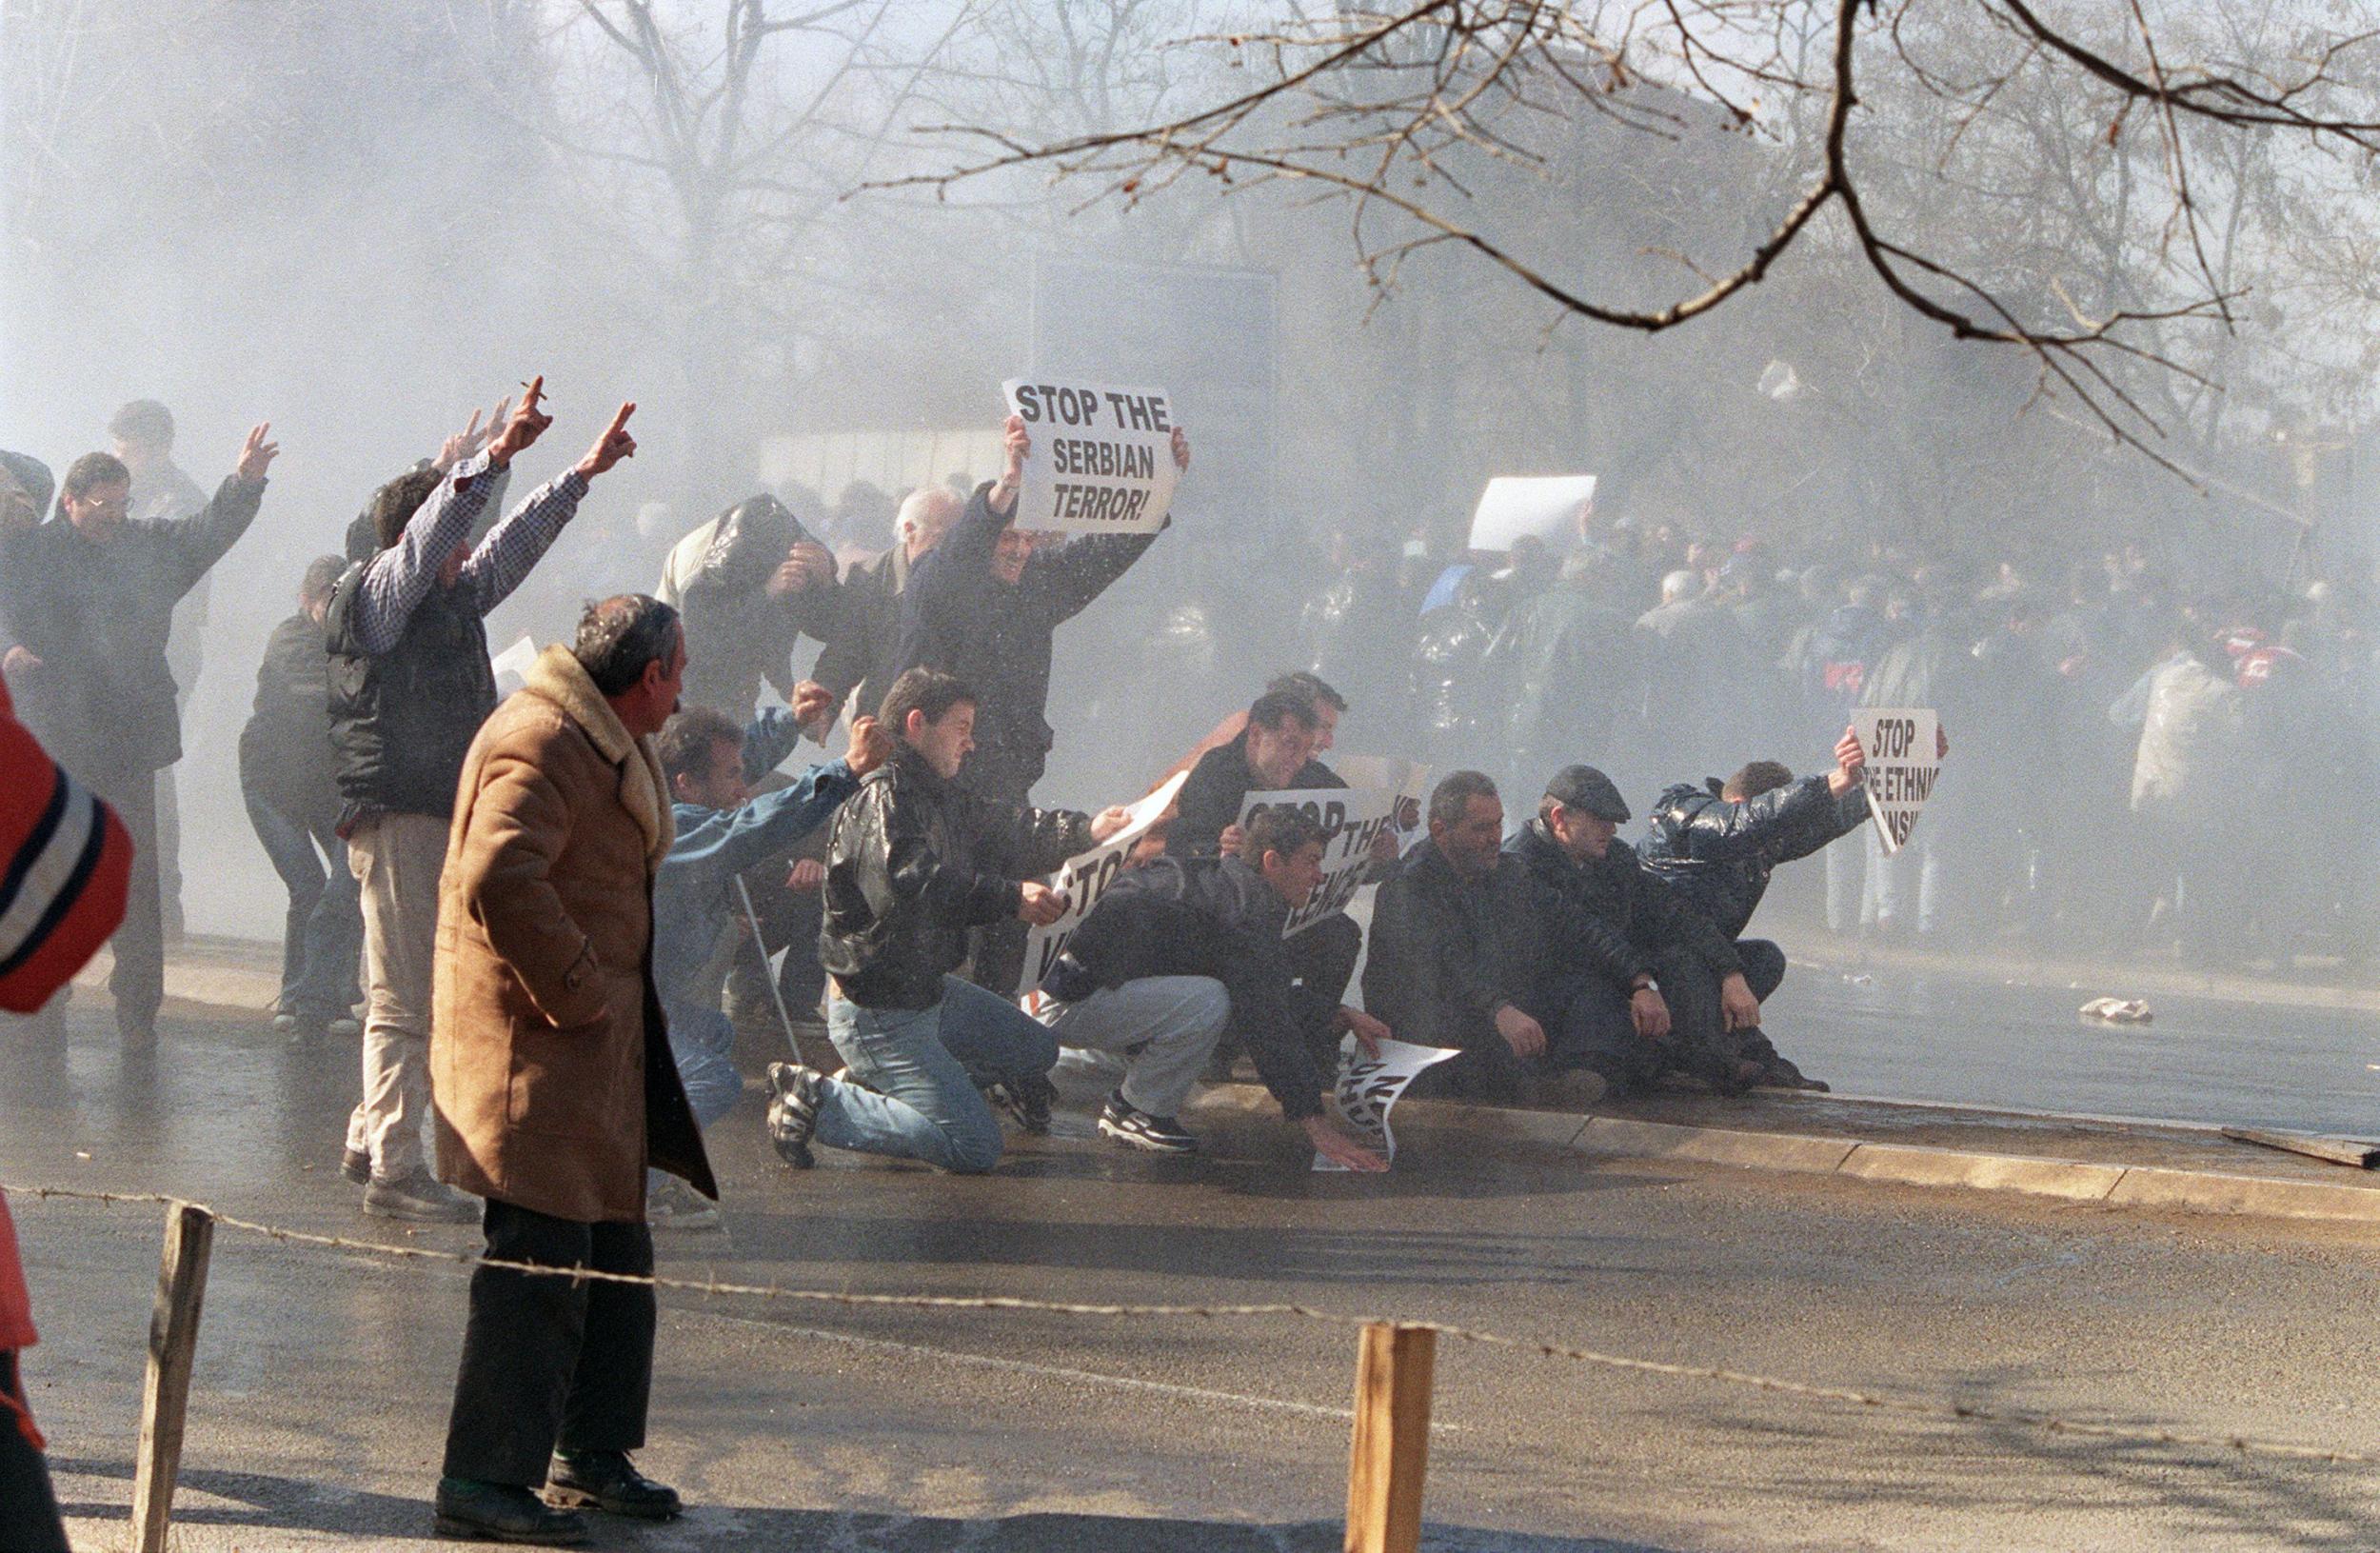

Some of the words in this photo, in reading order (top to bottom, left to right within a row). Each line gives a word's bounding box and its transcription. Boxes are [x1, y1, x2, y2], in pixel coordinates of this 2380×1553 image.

[1015, 385, 1099, 427] STOP
[1104, 391, 1171, 433] THE
[1052, 438, 1155, 480] SERBIAN
[1053, 484, 1151, 521] TERROR!
[1873, 719, 1915, 758] STOP
